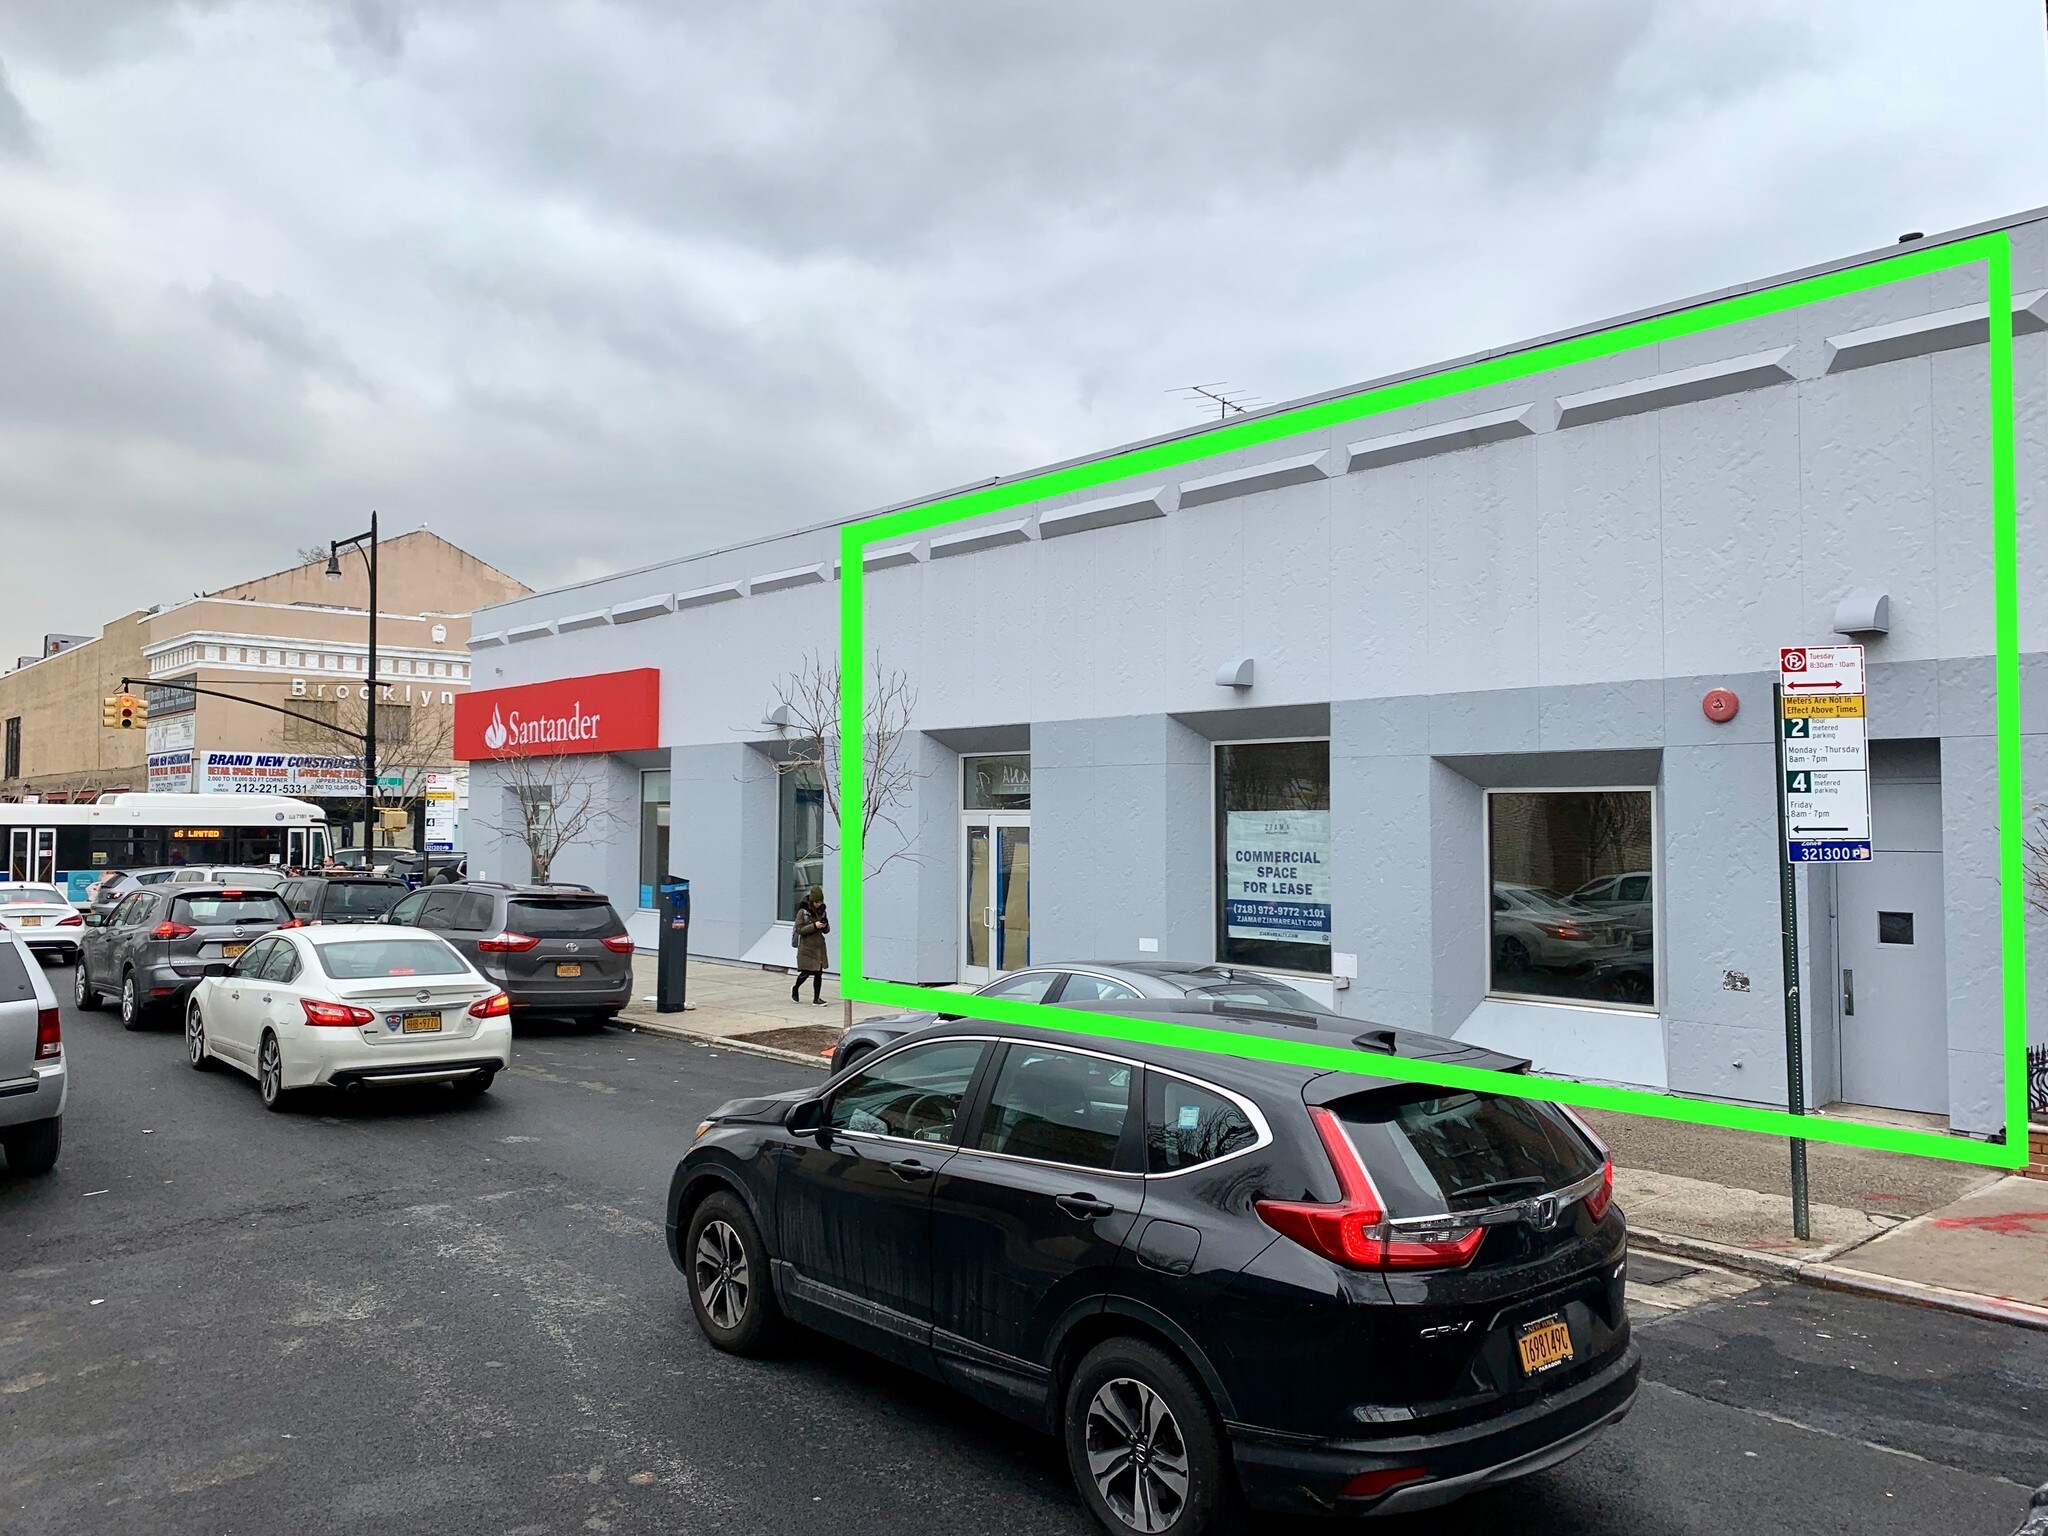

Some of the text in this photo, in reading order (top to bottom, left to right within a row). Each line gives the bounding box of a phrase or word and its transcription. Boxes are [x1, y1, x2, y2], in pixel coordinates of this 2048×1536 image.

[291, 677, 453, 708] Brooklyn
[509, 701, 600, 746] Santander
[1791, 718, 1804, 736] 2
[1825, 746, 1860, 754] Thursday
[208, 754, 252, 765] BRAND
[255, 756, 285, 767] NEW
[1812, 755, 1828, 763] 7pm
[208, 767, 288, 776] RETAIL SPACE FOR LEASE
[235, 783, 307, 794] 212-221-5331
[1792, 772, 1807, 792] 4
[1814, 810, 1830, 818] 7pm
[1236, 850, 1320, 864] COMMERCIAL
[1802, 847, 1850, 860] 321300
[1257, 867, 1297, 879] SPACE
[1243, 881, 1313, 895] FOR LEASE
[1233, 903, 1325, 918] (718) 972-9772 x101
[1522, 1326, 1568, 1364] T698149C
[1539, 1360, 1562, 1372] PARAGON
